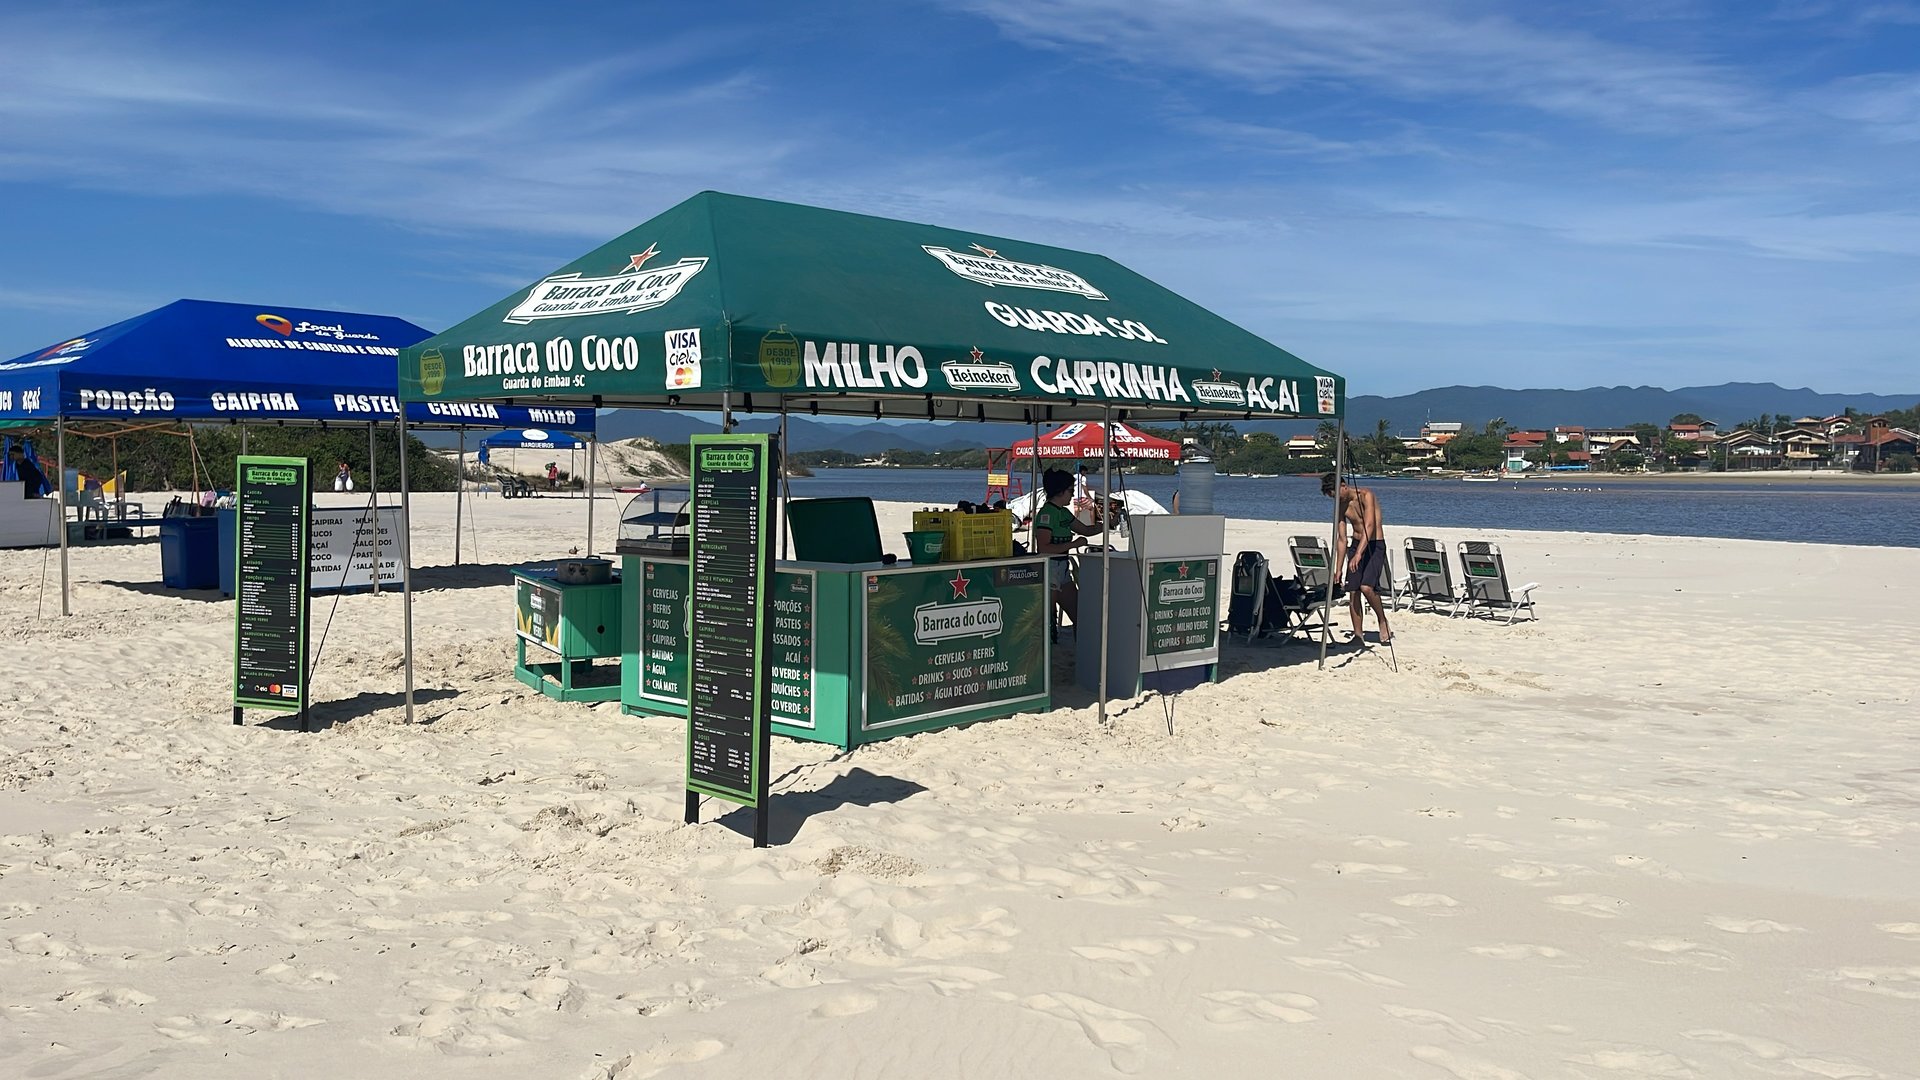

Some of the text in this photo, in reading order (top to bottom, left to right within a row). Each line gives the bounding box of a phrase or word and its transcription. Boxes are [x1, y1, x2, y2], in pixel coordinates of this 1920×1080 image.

[946, 253, 1077, 283] Barraca do Coco
[966, 267, 1010, 281] Guarda
[541, 271, 682, 301] Barraca do Coco
[533, 300, 577, 313] Guarda
[580, 298, 597, 309] do
[295, 321, 344, 333] Local
[984, 301, 1168, 345] GUARDA SOL
[226, 338, 285, 349] ALUGUEL
[284, 340, 302, 350] DE
[304, 341, 358, 354] CADEIRA
[669, 331, 697, 349] VISA
[463, 335, 639, 378] Barraca do Coco
[767, 348, 796, 357] DESDE
[424, 362, 442, 370] DESDE
[770, 357, 792, 366] 1999
[804, 340, 928, 389] MILHO
[949, 368, 1013, 384] Heineken
[1030, 355, 1191, 402] CAIPIRINHA
[1197, 385, 1241, 399] Heineken
[503, 374, 585, 389] Guarda do Embau -SC
[1319, 378, 1334, 388] VISA
[22, 386, 41, 414] AÇAÍ
[80, 388, 576, 425] PORÇÃO CAIPIRA PASTEL CERVEJA MILHO
[521, 441, 555, 449] BARQUEIROS
[1051, 445, 1075, 455] GUARDA
[706, 453, 726, 461] Barraca
[311, 518, 343, 526] CAIPIRAS
[311, 539, 392, 550] AÇAÍ SALGDOS
[311, 551, 382, 561] COCO PASTIS
[311, 564, 342, 572] BATIDAS
[356, 562, 384, 570] SALAA
[369, 572, 395, 581] FUTAS
[1009, 571, 1025, 580] PAULO
[1025, 570, 1039, 578] LOPES
[652, 588, 678, 600] CERVEJAS
[1163, 585, 1203, 597] Barraca do Coco
[652, 603, 671, 615] REFRIS
[1154, 609, 1173, 620] DRINKS
[1192, 607, 1199, 617] DE
[1199, 606, 1211, 616] COCO
[652, 618, 670, 630] SUCOS
[775, 616, 801, 630] PASTEIS
[923, 609, 998, 632] Barraca do Coco
[1156, 620, 1209, 634] SUCOS MILHO VERDE
[652, 633, 676, 646] CAIPIRAS
[1158, 633, 1206, 648] CAIPIRAS BATIDAS
[652, 649, 674, 662] BATIDAS
[934, 646, 995, 666] CERVEJAS REFRIS
[652, 662, 666, 676] ÁGUA
[779, 667, 801, 681] VERDE
[918, 661, 1009, 685] DRINKS SUCOS CAIPIRAS
[652, 678, 678, 693] CHÁ MATE
[895, 674, 1027, 707] BATIDAS ÁGUA DE COCO MILHO VERDE
[780, 700, 802, 715] VERDE
